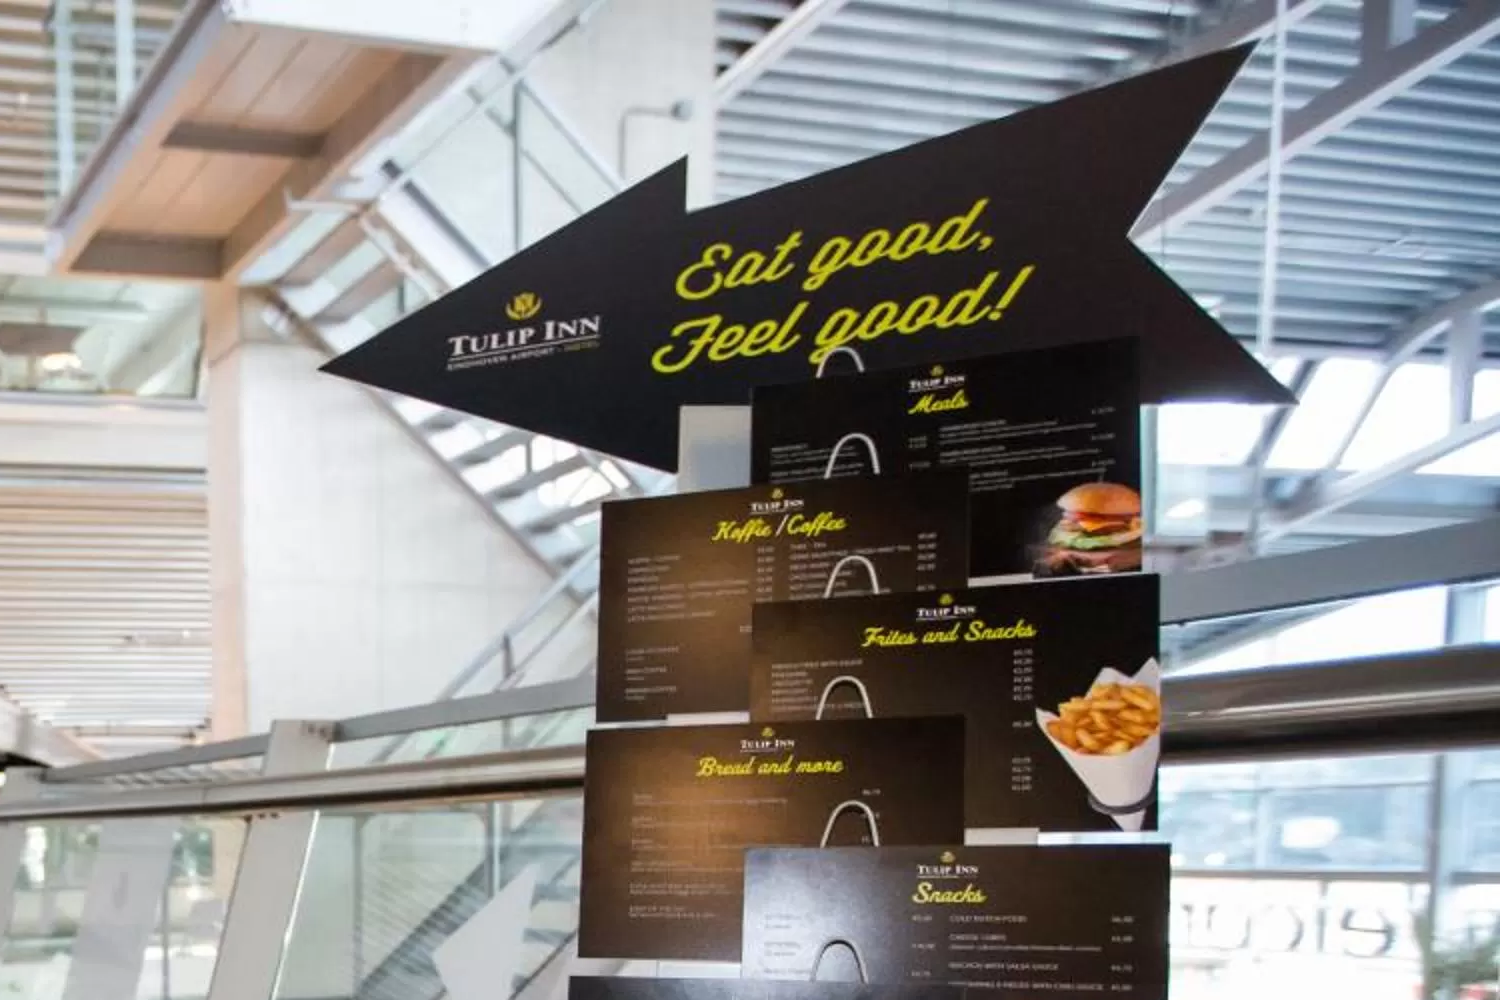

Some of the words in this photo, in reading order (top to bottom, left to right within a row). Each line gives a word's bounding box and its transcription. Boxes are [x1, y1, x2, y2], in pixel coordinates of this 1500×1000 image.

[675, 230, 804, 301] Eat
[802, 198, 995, 292] good,
[651, 301, 810, 374] Feel
[808, 264, 1036, 366] good!
[447, 326, 536, 357] TULIP
[543, 314, 602, 341] INN
[907, 389, 970, 416] Meals
[860, 626, 918, 649] Frites
[920, 621, 961, 644] and
[963, 618, 1039, 643] Snacks
[694, 754, 755, 778] Bread
[756, 755, 794, 776] and
[795, 757, 845, 775] more
[911, 881, 988, 905] Snacks
